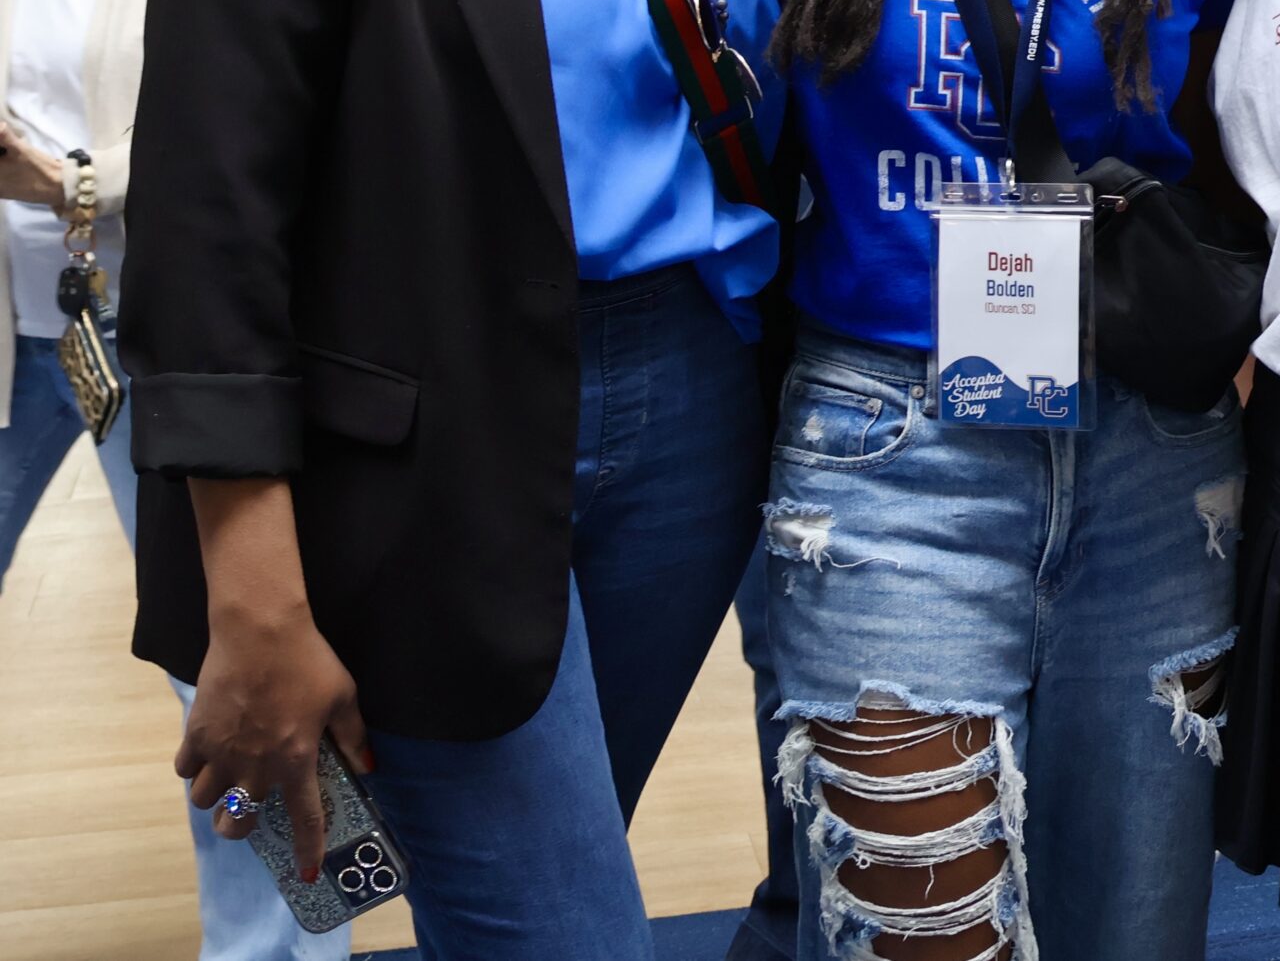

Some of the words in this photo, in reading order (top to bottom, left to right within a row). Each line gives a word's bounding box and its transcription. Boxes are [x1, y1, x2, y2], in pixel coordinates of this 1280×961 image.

[988, 251, 1034, 277] Dejah
[986, 279, 1035, 298] Bolden
[942, 372, 1007, 391] Accepted
[947, 385, 1003, 403] Student
[1026, 374, 1069, 418] PC
[953, 401, 987, 419] Day
